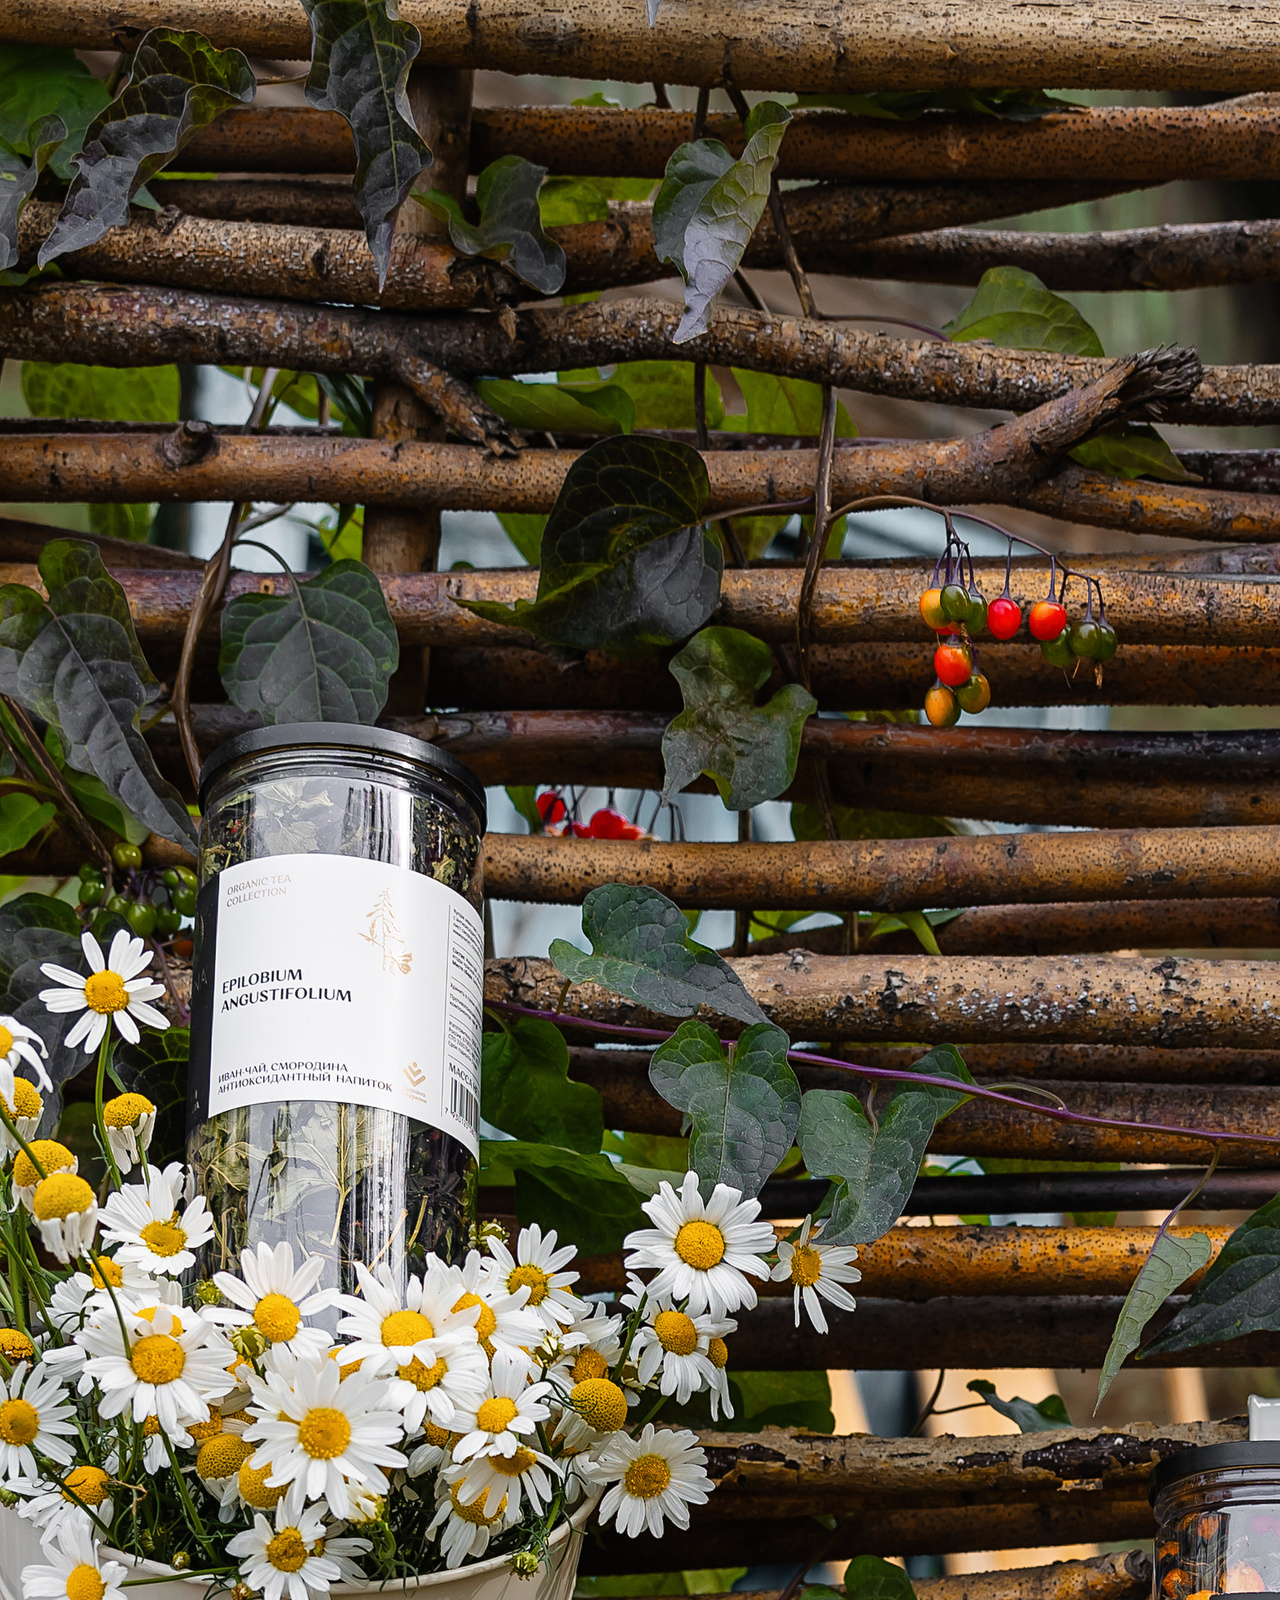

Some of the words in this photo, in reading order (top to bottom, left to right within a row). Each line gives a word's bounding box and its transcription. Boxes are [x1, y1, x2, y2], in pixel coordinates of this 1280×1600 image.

[227, 877, 269, 896] ORGANIC
[270, 874, 292, 886] TEA
[226, 886, 288, 908] COLLECTION
[221, 968, 303, 995] EPILOBIUM
[221, 986, 352, 1013] ANGUSTIFOLIUM
[217, 1062, 269, 1084] ИВАН-ЧАЙ,
[270, 1061, 349, 1073] СМОРОДИНА
[217, 1071, 331, 1095] АНТИОКСИДАНТНЫЙ
[335, 1073, 393, 1093] НАПИТОК
